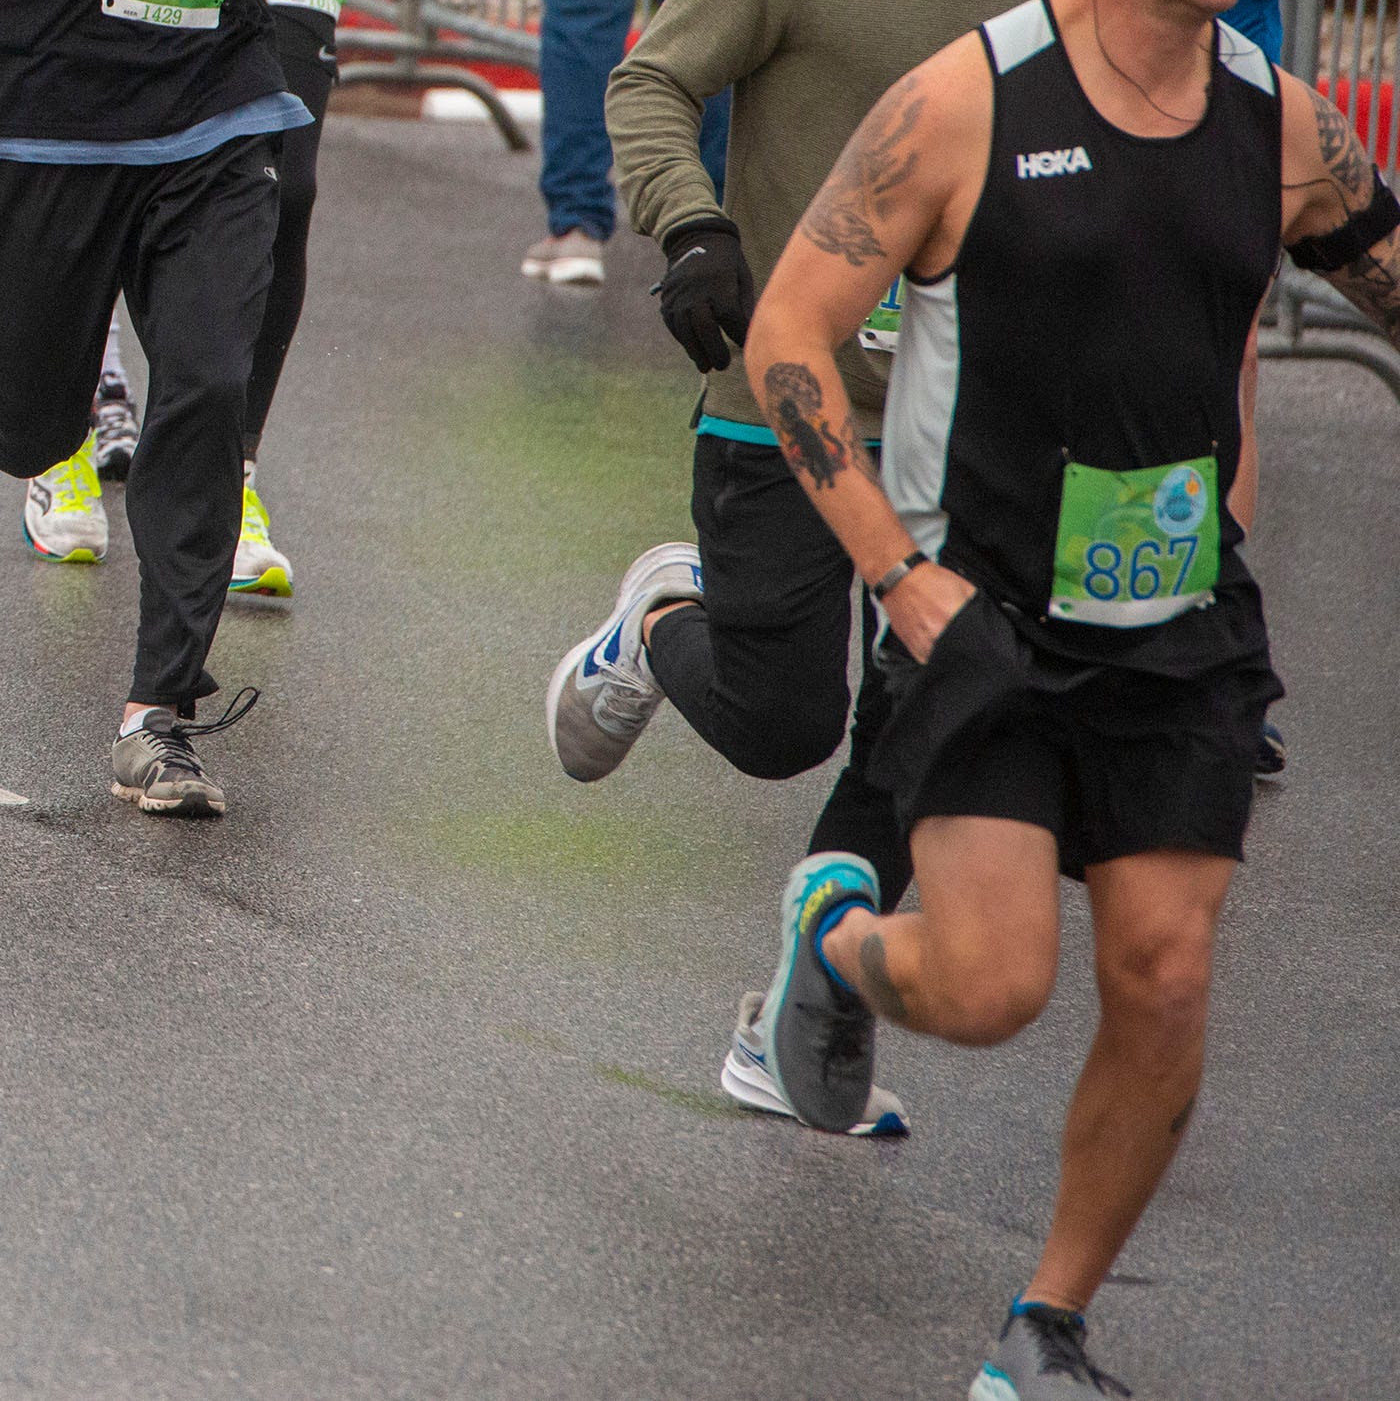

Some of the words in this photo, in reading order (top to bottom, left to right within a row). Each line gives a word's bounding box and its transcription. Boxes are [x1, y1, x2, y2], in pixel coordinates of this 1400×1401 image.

[141, 4, 183, 25] 1429
[1015, 146, 1093, 180] HOKA
[1083, 536, 1198, 601] 867
